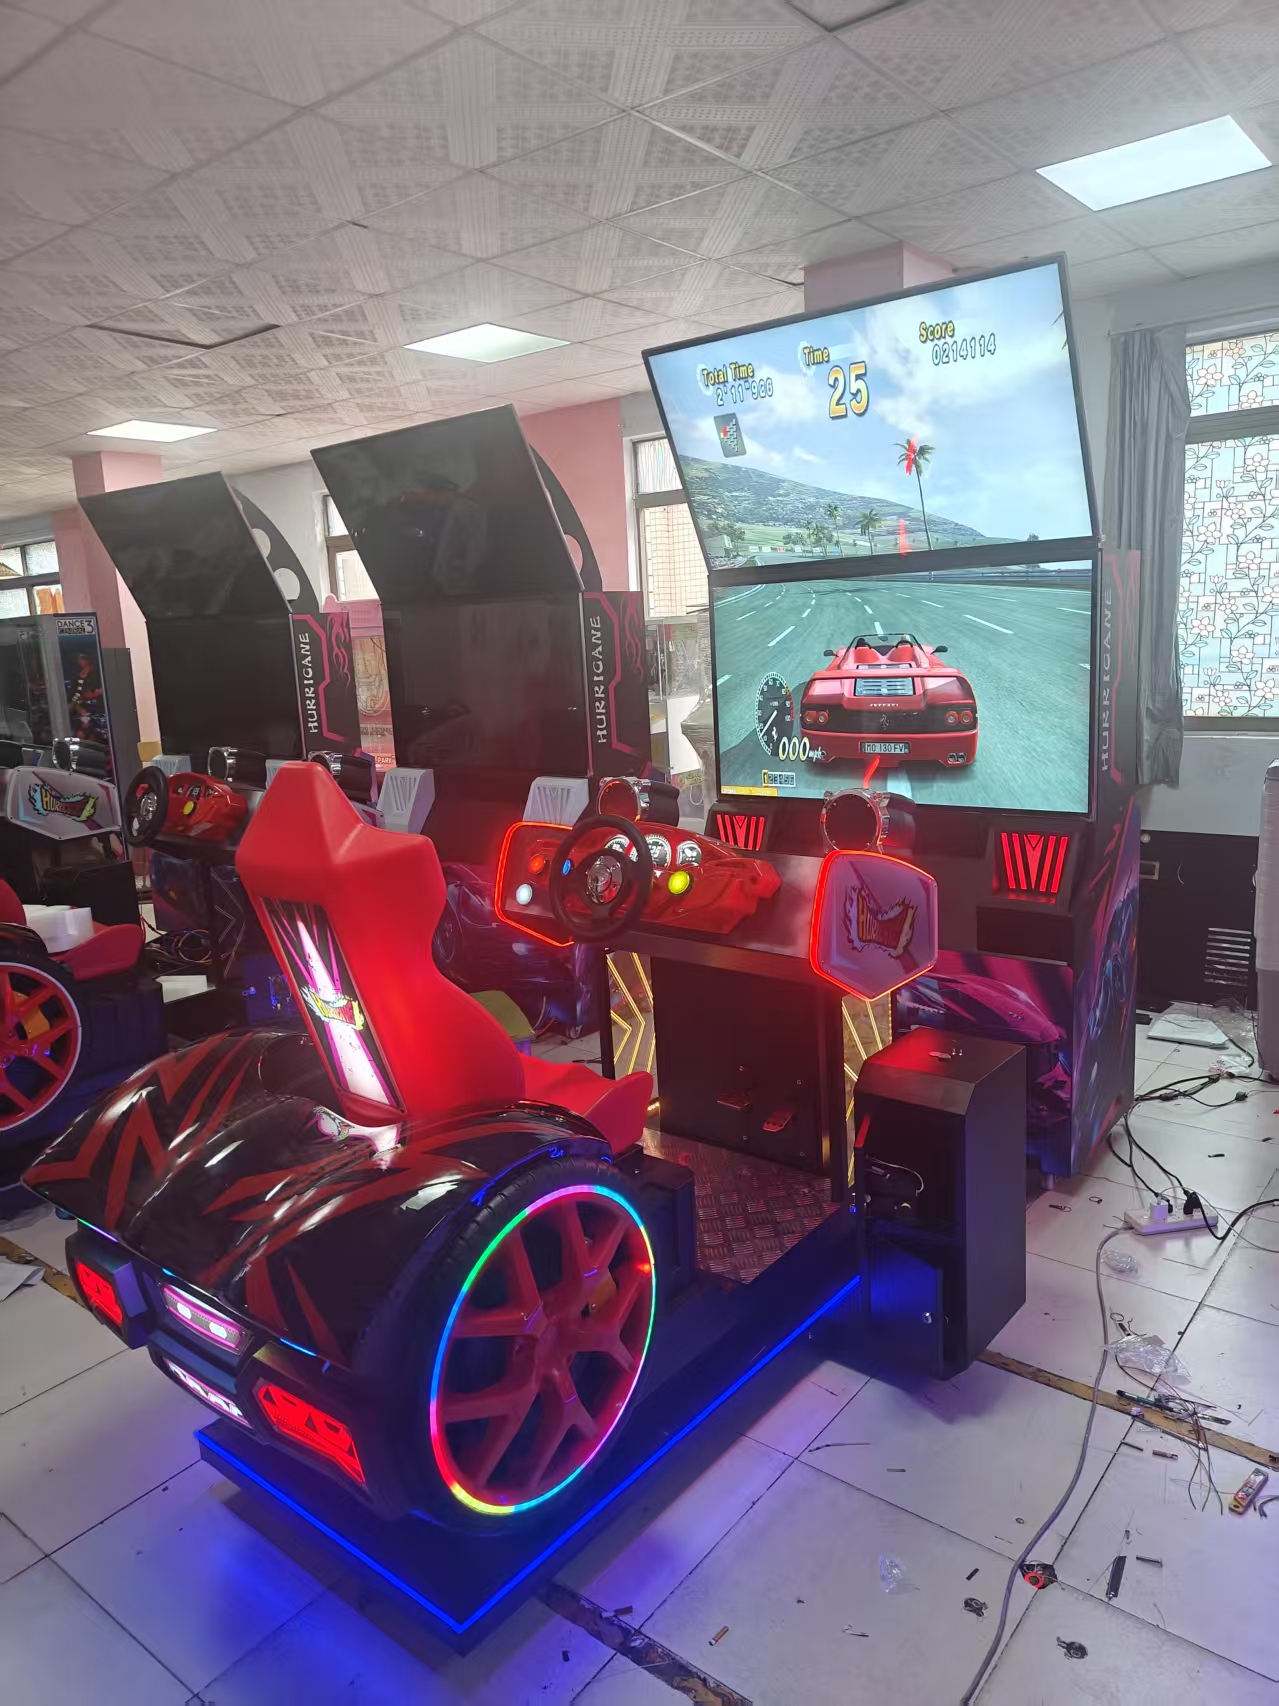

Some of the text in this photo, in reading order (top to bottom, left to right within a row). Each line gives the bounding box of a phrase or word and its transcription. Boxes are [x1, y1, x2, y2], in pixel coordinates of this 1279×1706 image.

[919, 320, 955, 343] Score
[803, 346, 830, 366] Time
[932, 332, 996, 366] 0214114
[702, 361, 754, 387] Total Time
[828, 361, 869, 419] 25
[57, 620, 94, 634] DANCE 3
[299, 633, 318, 733] HURRICANE
[590, 615, 607, 743] HURRICANE
[1102, 587, 1112, 771] HURRICANE
[778, 736, 822, 762] 000 mph
[880, 743, 893, 753] 130
[894, 743, 904, 753] FV
